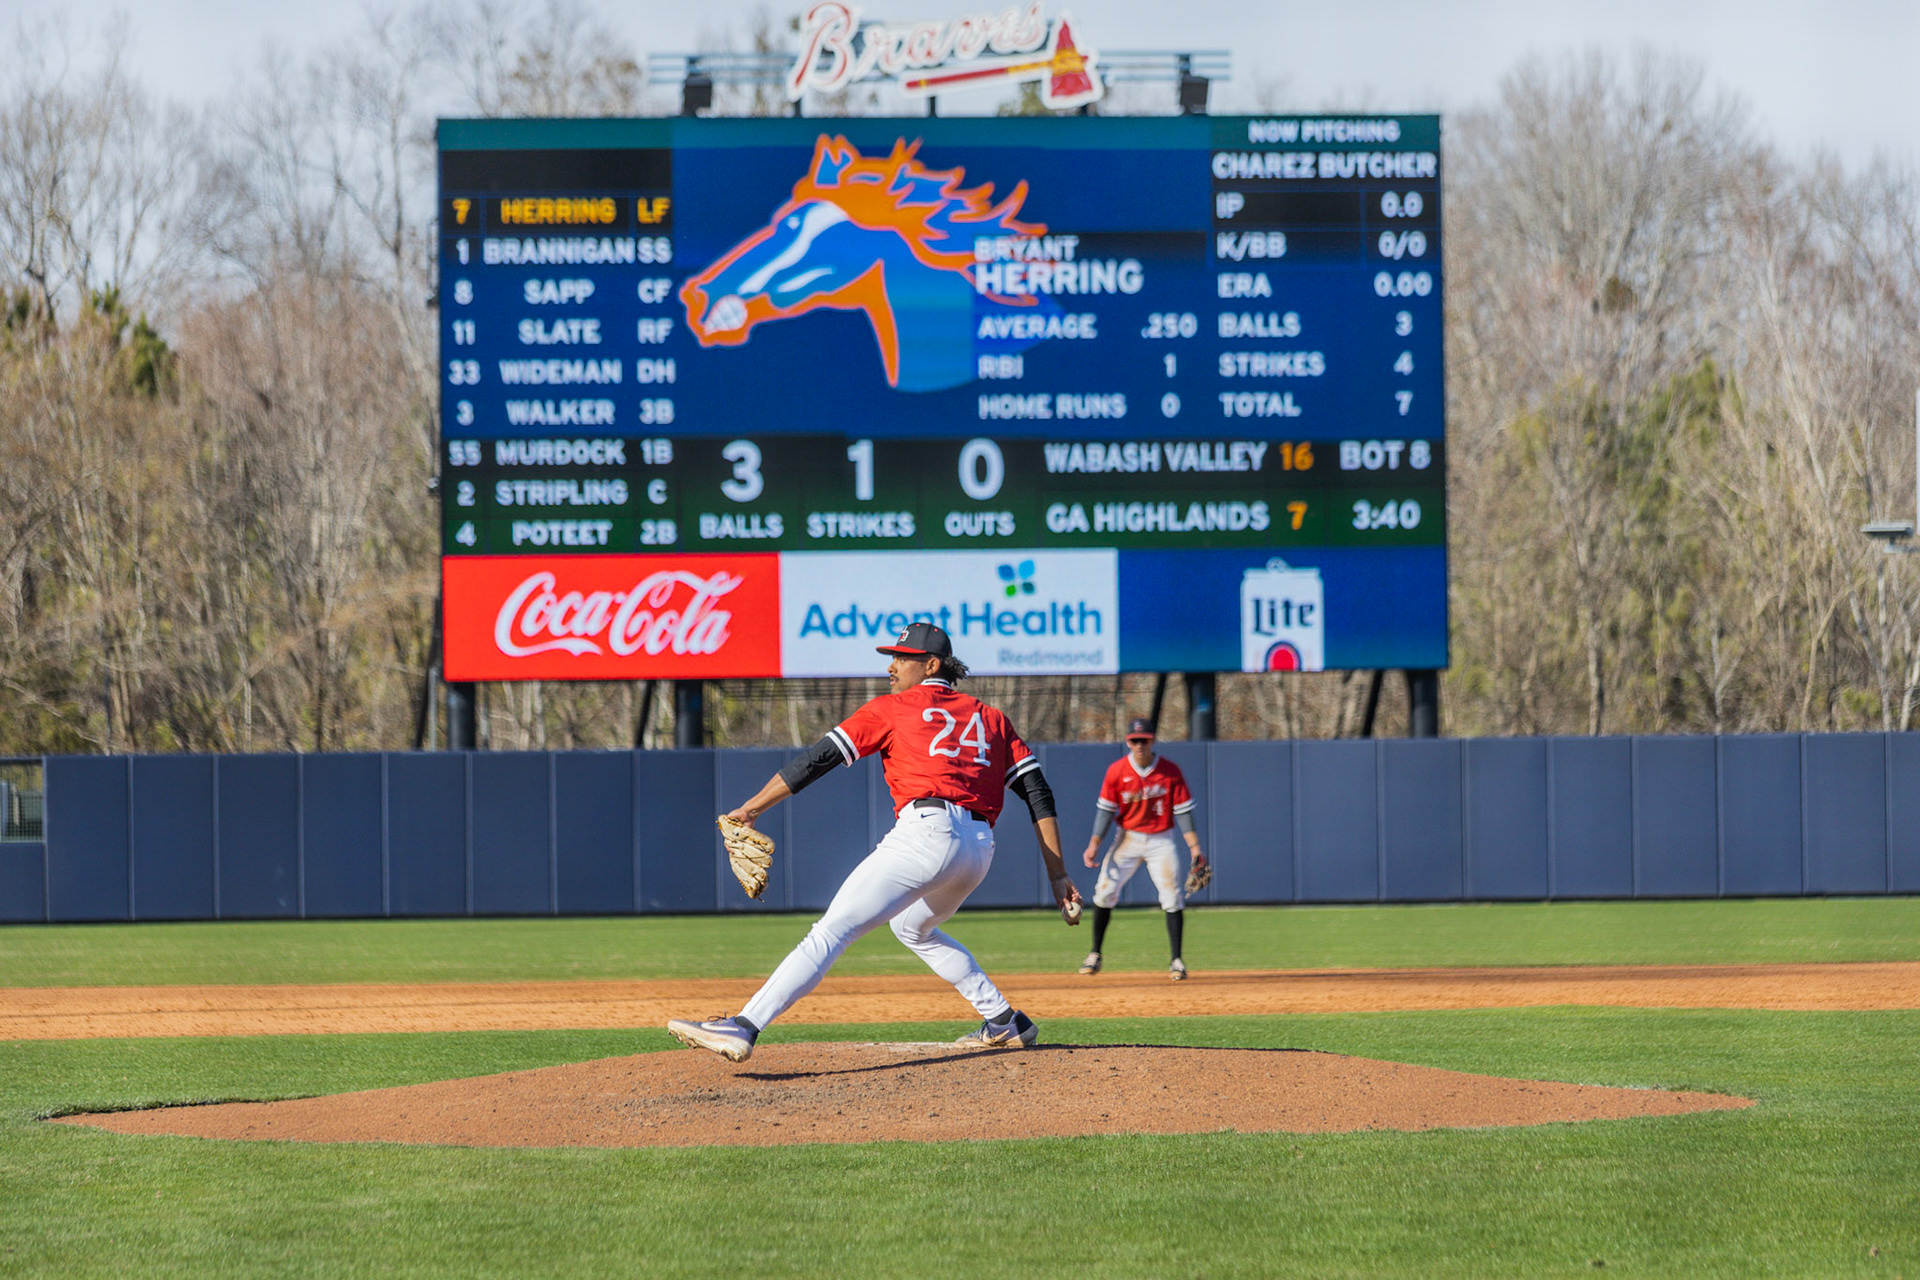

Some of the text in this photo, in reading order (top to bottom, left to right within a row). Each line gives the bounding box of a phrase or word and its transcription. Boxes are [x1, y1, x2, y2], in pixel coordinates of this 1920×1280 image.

[790, 1, 1048, 100] Braves
[1248, 119, 1401, 143] NOW PITCHING
[1212, 151, 1437, 179] CHAREZ BUTCHER
[452, 197, 671, 224] 7 HERRING LF
[1216, 190, 1423, 219] IP 0.0
[456, 237, 673, 265] 1 BRANNIGAN SS
[974, 234, 1079, 262] BRYANT
[1216, 230, 1427, 262] K/BB 0/0
[975, 258, 1144, 294] HERRING
[1217, 271, 1433, 298] ERA 0.00
[454, 278, 673, 305] 8 SAPP CF
[452, 317, 674, 345] 11 SLATE RF
[977, 312, 1198, 339] AVERAGE .250
[1218, 310, 1413, 338] BALLS 3
[449, 358, 676, 385] 33 WIDEMAN DH
[978, 353, 1177, 379] RBI 1
[1218, 350, 1414, 377] STRIKES 4
[456, 399, 675, 426] 3 WALKER 3B
[978, 392, 1181, 420] HOME RUNS 0
[1218, 391, 1413, 417] TOTAL 7
[449, 439, 674, 466] 55 MURDOCK 1B
[1044, 441, 1315, 473] WABASH VALLEY 16
[1339, 440, 1431, 471] BOT 8
[720, 437, 1005, 503] 3 1 0
[457, 479, 667, 506] 2 STRIPLING C
[699, 514, 784, 540] BALLS
[806, 512, 916, 538] STRIKES
[944, 511, 1016, 537] OUTS
[1046, 501, 1308, 533] GA HIGHLANDS 7
[1352, 499, 1422, 530] 3:40
[455, 519, 677, 546] 4 POTEET 2B
[494, 570, 746, 657] Coca-Cola
[1253, 598, 1314, 637] Lite
[999, 650, 1103, 665] Redmond
[922, 707, 991, 767] 24
